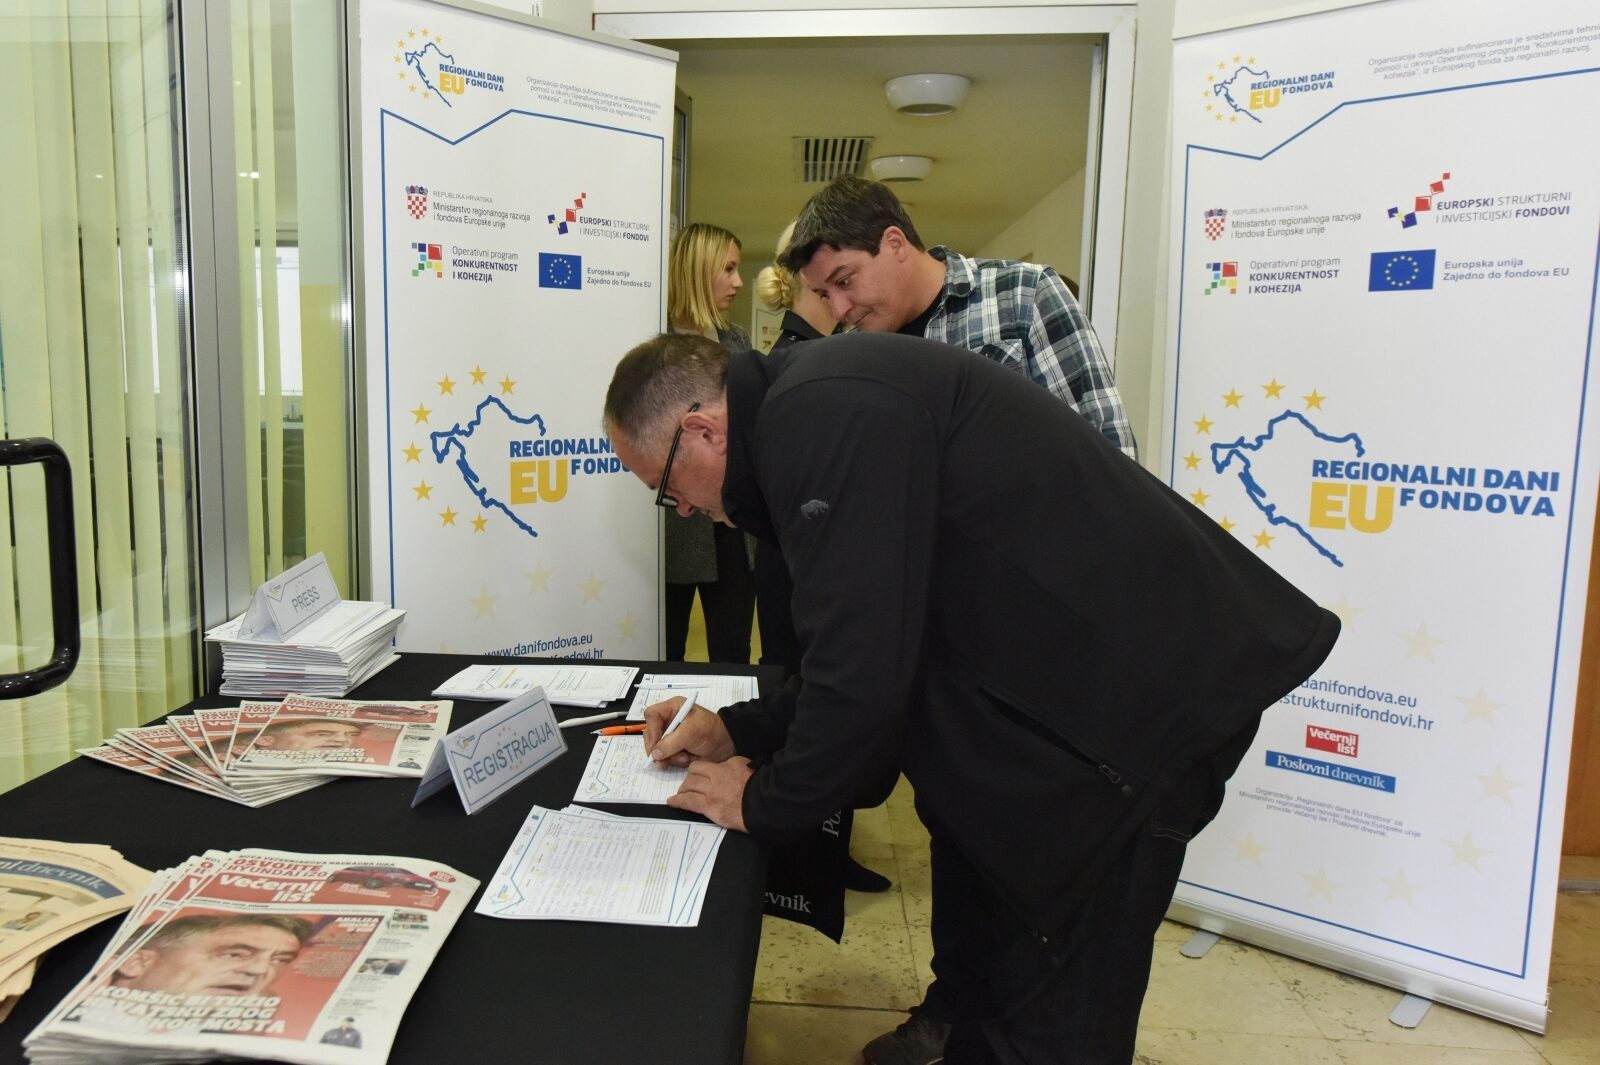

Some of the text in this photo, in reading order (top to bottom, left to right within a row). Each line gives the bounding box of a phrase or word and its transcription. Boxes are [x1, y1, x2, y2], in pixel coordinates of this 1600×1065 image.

[1368, 54, 1416, 66] Organizacija
[1456, 38, 1513, 52] sufinancirana
[1515, 36, 1524, 45] je
[1526, 28, 1574, 41] sredstvima
[1374, 64, 1402, 74] pomoći
[1411, 60, 1435, 68] okviru
[1436, 52, 1486, 64] Operativnog
[1489, 44, 1530, 56] programa
[1432, 61, 1475, 74] Europskog
[1478, 58, 1502, 66] fonda
[1516, 49, 1560, 60] regionalni
[440, 64, 504, 84] REGIONALNI DANI
[1250, 72, 1335, 90] REGIONALNI DANI
[440, 72, 464, 95] EU
[466, 78, 504, 92] FONDOVA
[1282, 81, 1334, 94] FONDOVA
[1250, 88, 1280, 110] EU
[433, 190, 493, 204] REPUBLIKA HRVATSKA
[1437, 192, 1572, 210] EUROPSKI STRUKTURNI
[433, 202, 530, 222] Ministarstvo regionalnoga razvoja
[1272, 204, 1308, 212] HRVATSKA
[1442, 210, 1512, 224] INVESTICIJSKI
[1515, 206, 1570, 218] FONDOVI
[436, 212, 462, 224] fondova
[464, 216, 492, 227] Europske
[493, 220, 506, 230] unije
[580, 216, 650, 231] EUROPSKI STRUKTURNI
[1232, 212, 1362, 228] Ministarstvo regionalnoga razvoja
[583, 228, 622, 239] INVESTICIJSKI
[623, 232, 650, 242] FONDOVI
[1235, 230, 1265, 238] fondova
[1268, 228, 1304, 239] Europske
[1306, 226, 1325, 236] unije
[452, 246, 518, 260] Operativni program
[452, 259, 518, 272] KONKURENTNOST
[1250, 258, 1340, 270] Operativni program
[1444, 258, 1524, 270] Europska unija
[458, 272, 492, 283] KOHEZIJA
[587, 268, 614, 276] Europska
[1250, 270, 1340, 282] KONKURENTNOST
[1443, 268, 1570, 282] Zajedno do fondova EU
[587, 277, 610, 286] Zajedno
[1254, 284, 1302, 294] KOHEZIJA
[510, 459, 568, 505] EU
[1312, 459, 1560, 492] REGIONALNI DANI
[1310, 482, 1395, 534] EU
[1400, 488, 1556, 517] FONDOVA
[291, 586, 320, 613] PRESS
[1310, 728, 1356, 746] Večernji
[463, 722, 554, 788] REGISTRACIJA
[1337, 743, 1356, 756] list
[1276, 755, 1386, 789] Poslovni dnevnik
[226, 865, 302, 877] HYUNDAI
[234, 858, 324, 872] OSVOJITE
[218, 874, 326, 892] Večernji
[272, 890, 316, 902] list
[764, 891, 812, 914] vnik
[205, 1019, 286, 1033] MOSTA
